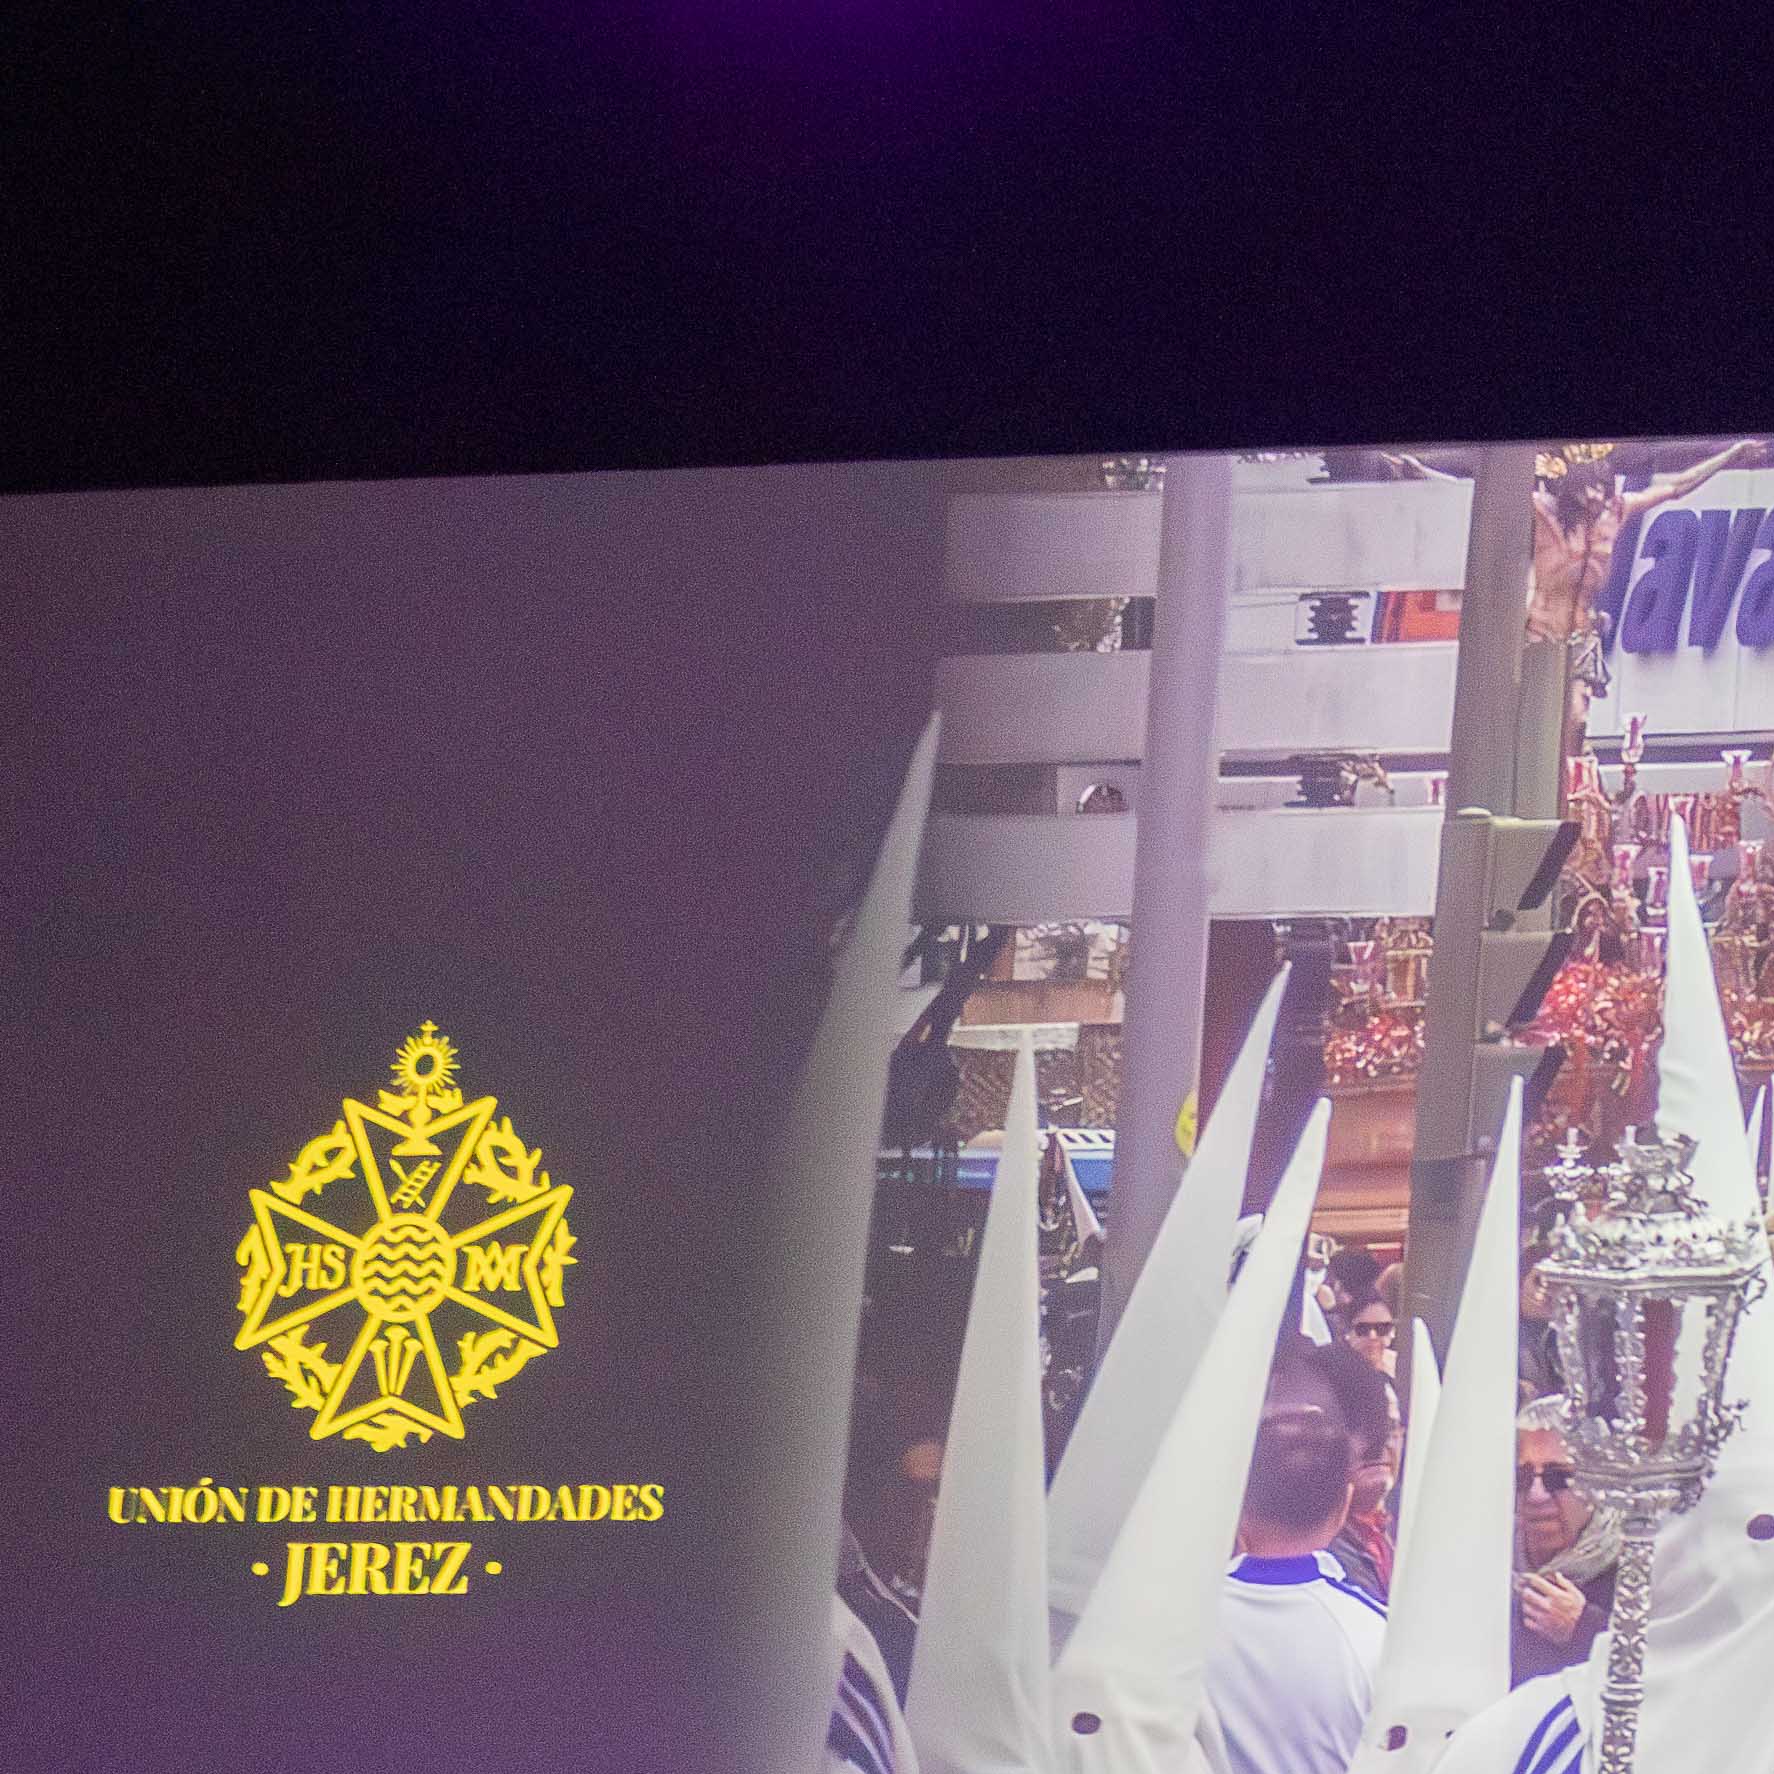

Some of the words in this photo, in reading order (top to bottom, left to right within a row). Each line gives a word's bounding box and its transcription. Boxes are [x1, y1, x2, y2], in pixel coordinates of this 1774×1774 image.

[107, 1476, 249, 1525] UNIÓN
[255, 1485, 319, 1524] DE
[325, 1483, 665, 1524] HERMANDADES
[278, 1541, 473, 1608] JEREZ
